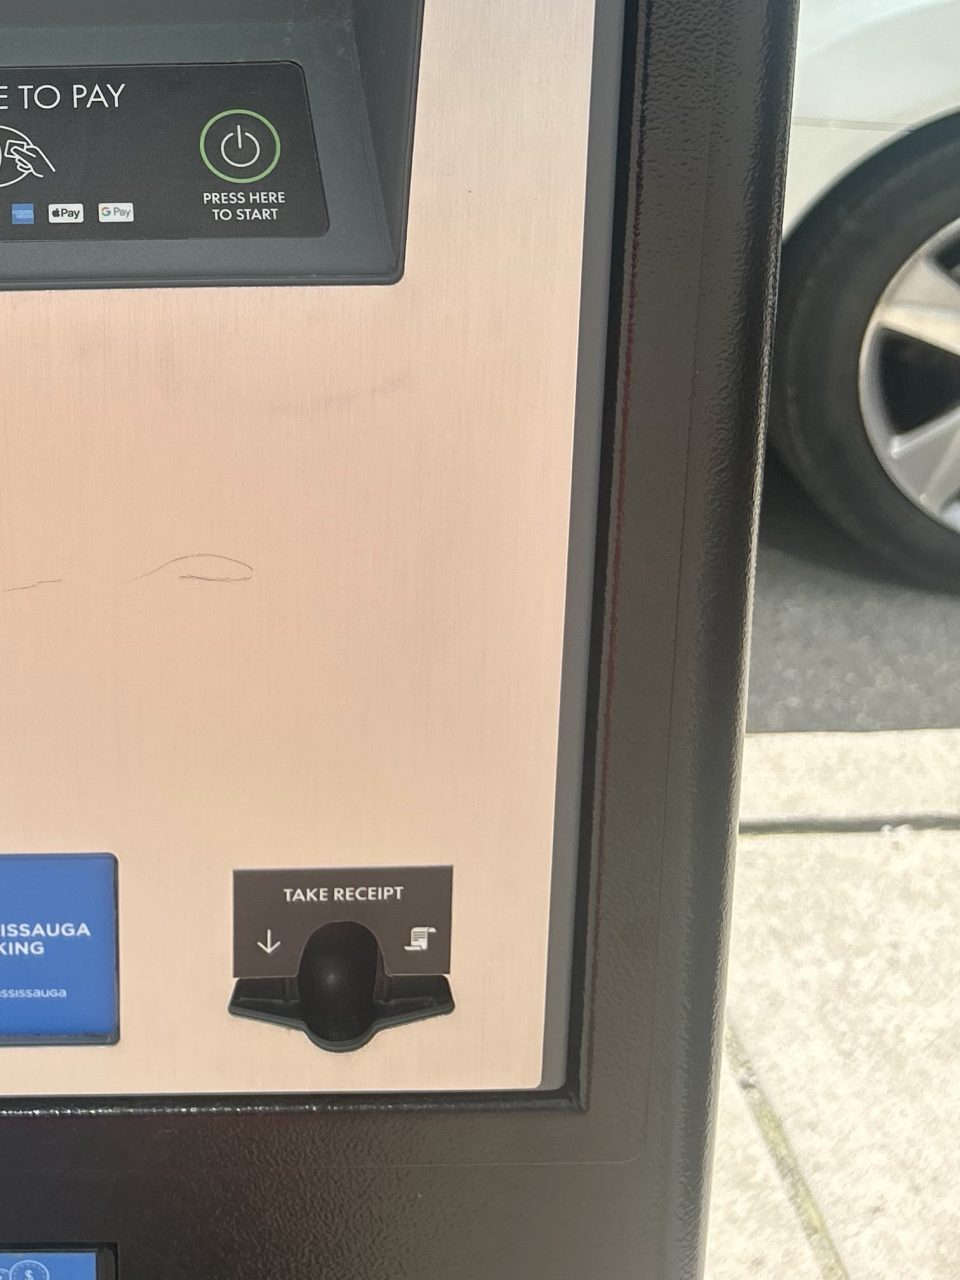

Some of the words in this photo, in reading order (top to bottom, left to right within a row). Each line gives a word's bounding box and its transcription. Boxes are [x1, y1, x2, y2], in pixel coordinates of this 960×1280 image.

[19, 85, 60, 110] TO
[73, 84, 126, 108] PAY
[202, 192, 245, 205] PRESS
[249, 191, 285, 204] HERE
[61, 208, 80, 219] Pay
[113, 207, 131, 218] Pay
[212, 208, 232, 221] TO
[235, 207, 279, 220] START
[283, 888, 328, 902] TAKE
[334, 885, 403, 901] RECEIPT
